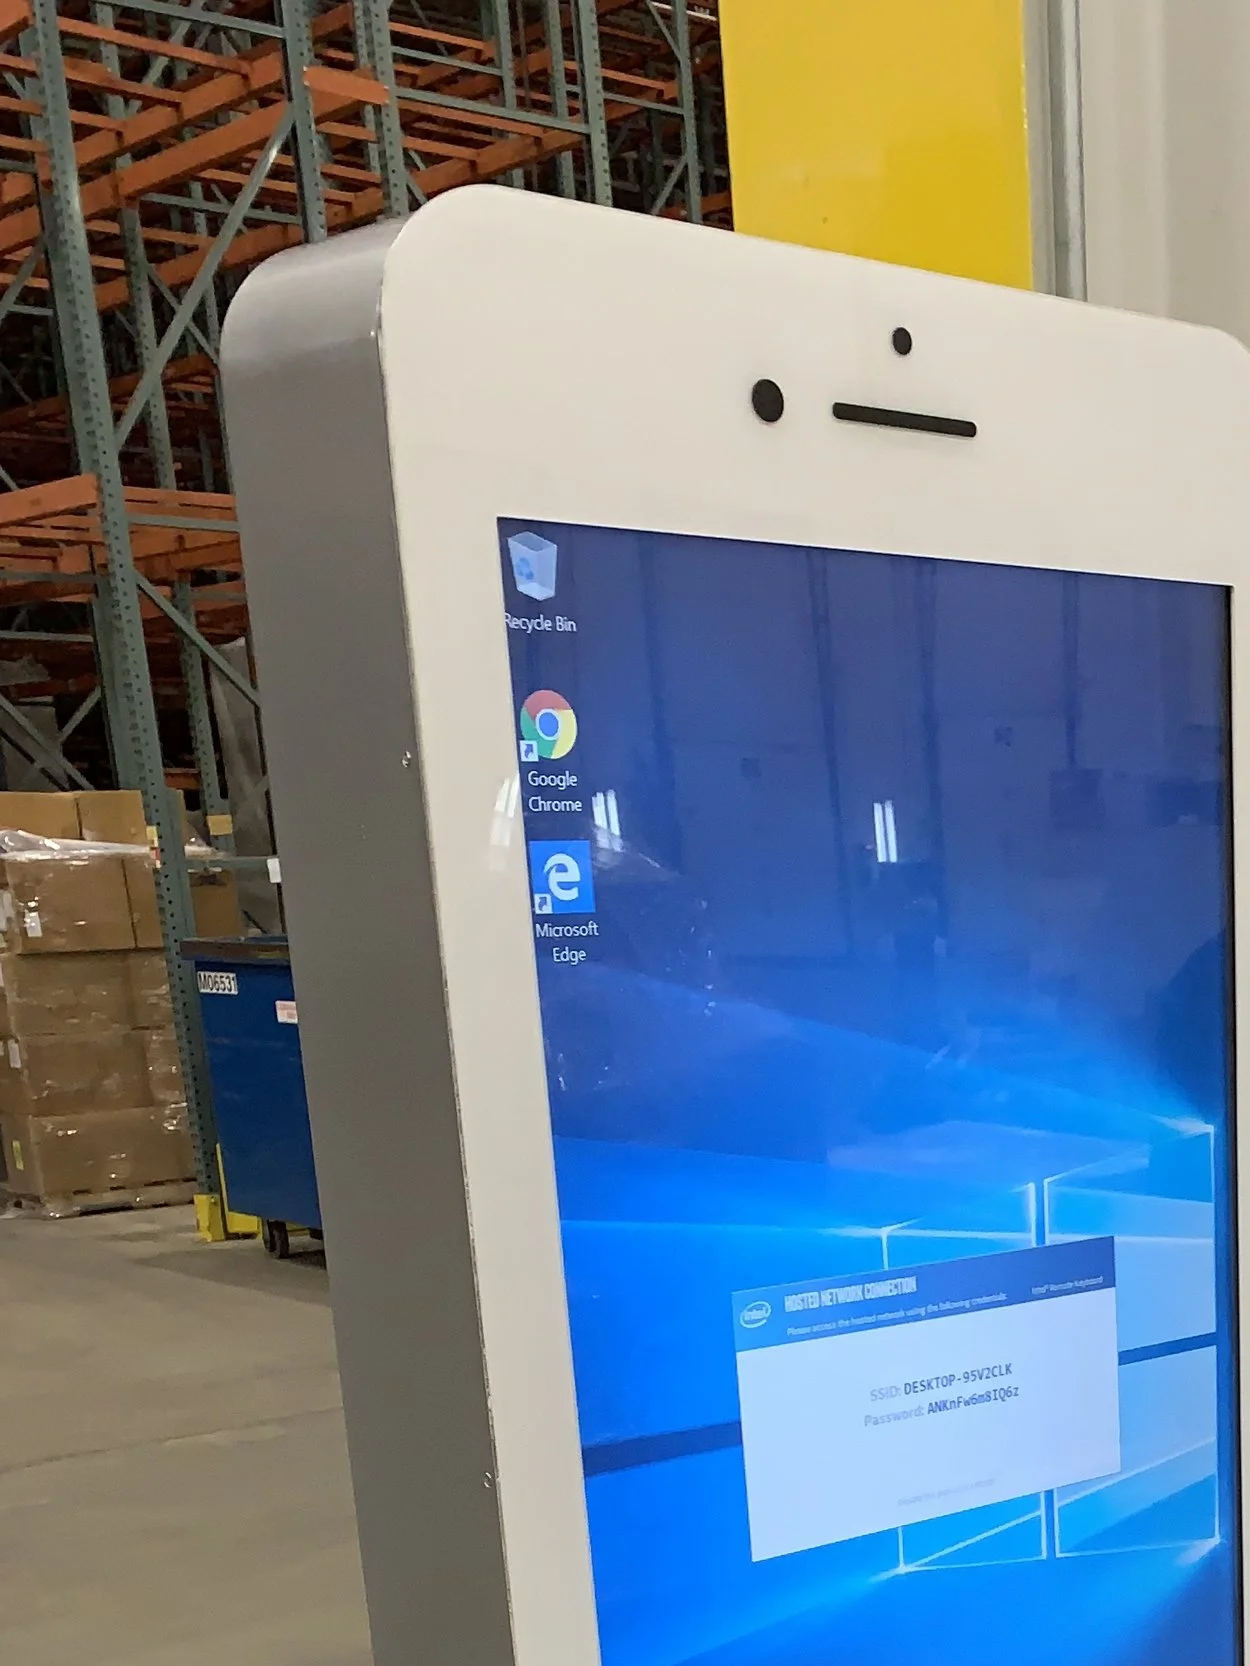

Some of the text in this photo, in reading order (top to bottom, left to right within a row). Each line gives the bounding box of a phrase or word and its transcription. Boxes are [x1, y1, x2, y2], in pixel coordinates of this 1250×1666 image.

[504, 612, 577, 634] Recycle Bin
[527, 770, 578, 791] Google
[528, 796, 583, 812] Chrome
[535, 920, 600, 938] Microsoft
[552, 946, 587, 966] Edge
[198, 974, 236, 992] M06531
[784, 1276, 917, 1313] HOSTED NETWORK CONNECTION
[869, 1362, 1013, 1402] SSID: DESKTOP-95V2CLK
[864, 1405, 925, 1427] Password:
